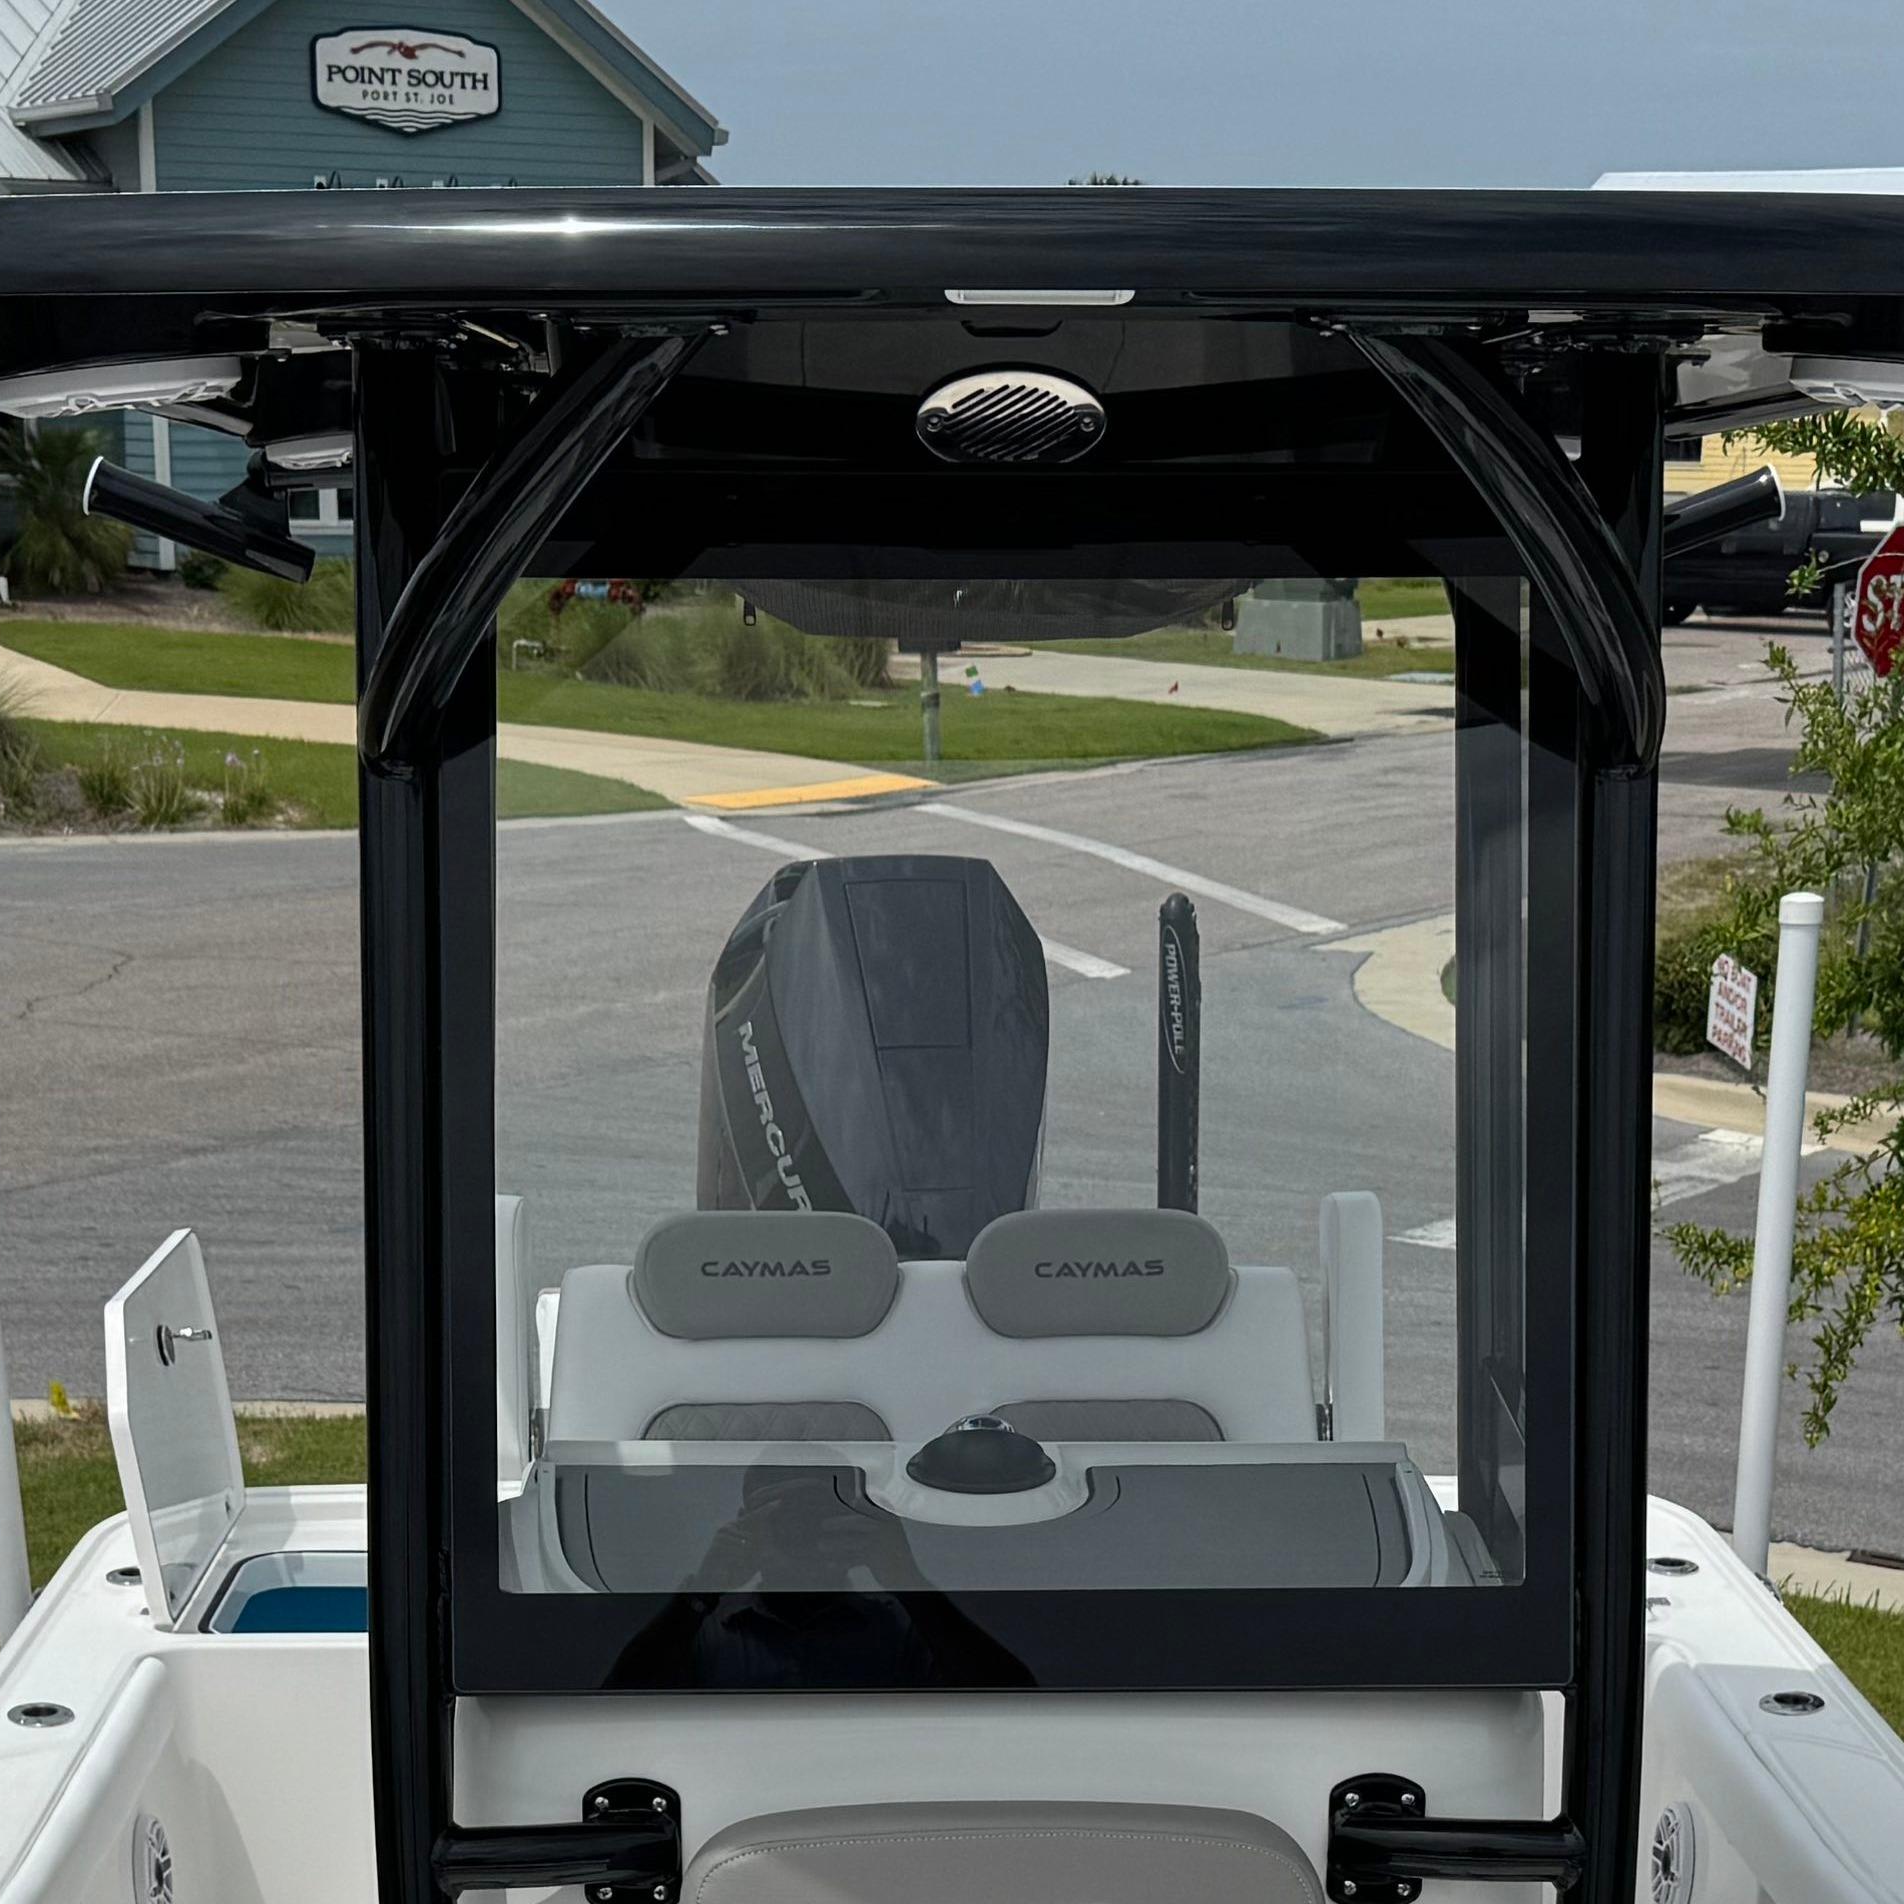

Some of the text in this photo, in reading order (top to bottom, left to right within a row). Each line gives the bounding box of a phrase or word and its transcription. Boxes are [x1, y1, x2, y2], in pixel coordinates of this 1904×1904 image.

[326, 64, 489, 91] POINT SOUTH
[362, 89, 455, 105] PORT ST. JOE
[1165, 943, 1185, 1055] POWER-POLE
[738, 1020, 813, 1211] MERCUR
[700, 1259, 832, 1279] CAYMAS
[1034, 1259, 1165, 1280] CAYMAS
